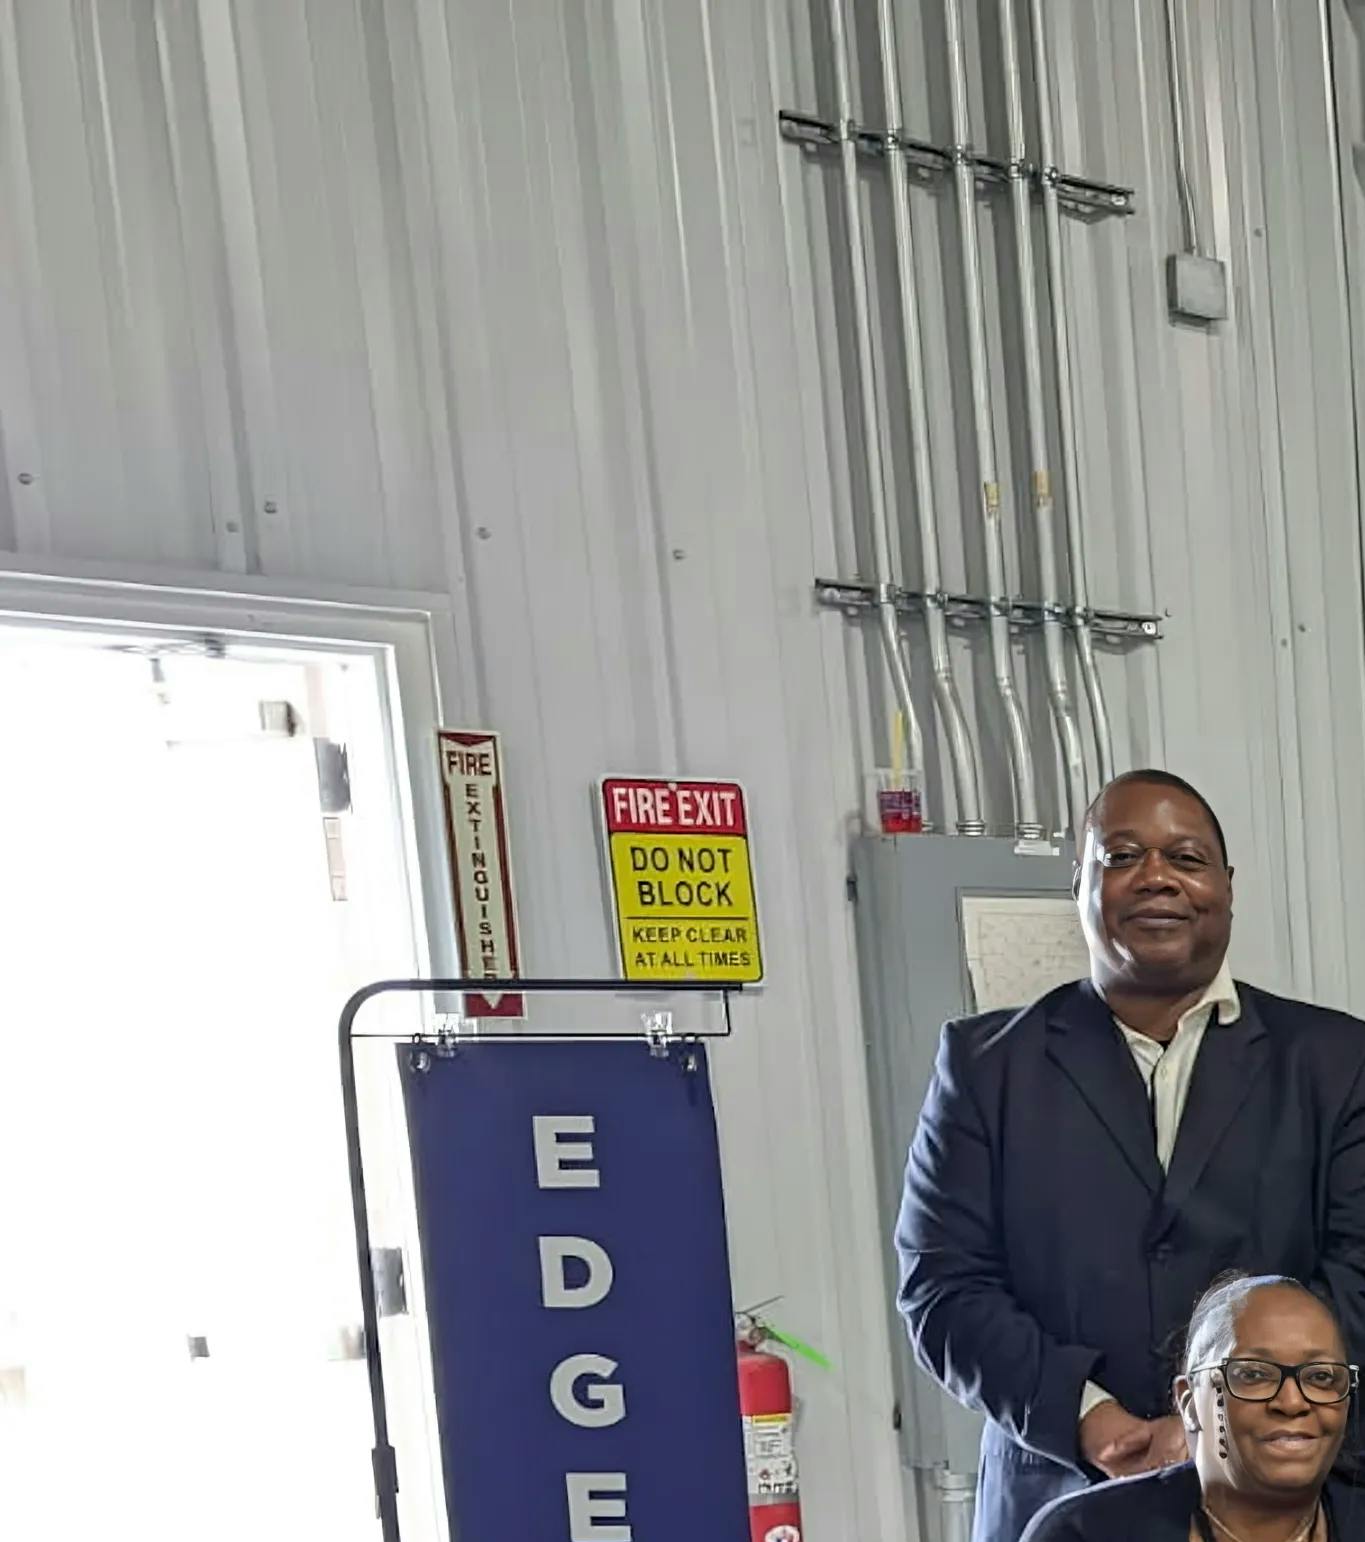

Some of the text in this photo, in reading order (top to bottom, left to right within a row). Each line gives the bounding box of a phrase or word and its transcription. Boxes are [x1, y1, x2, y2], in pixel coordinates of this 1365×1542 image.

[447, 751, 492, 776] FIRE
[613, 787, 736, 826] FIRE EXIT
[630, 847, 732, 873] DO NOT
[638, 881, 734, 906] BLOCK
[632, 926, 747, 943] KEEP CLEAR
[635, 952, 751, 967] AT ALL TIMES
